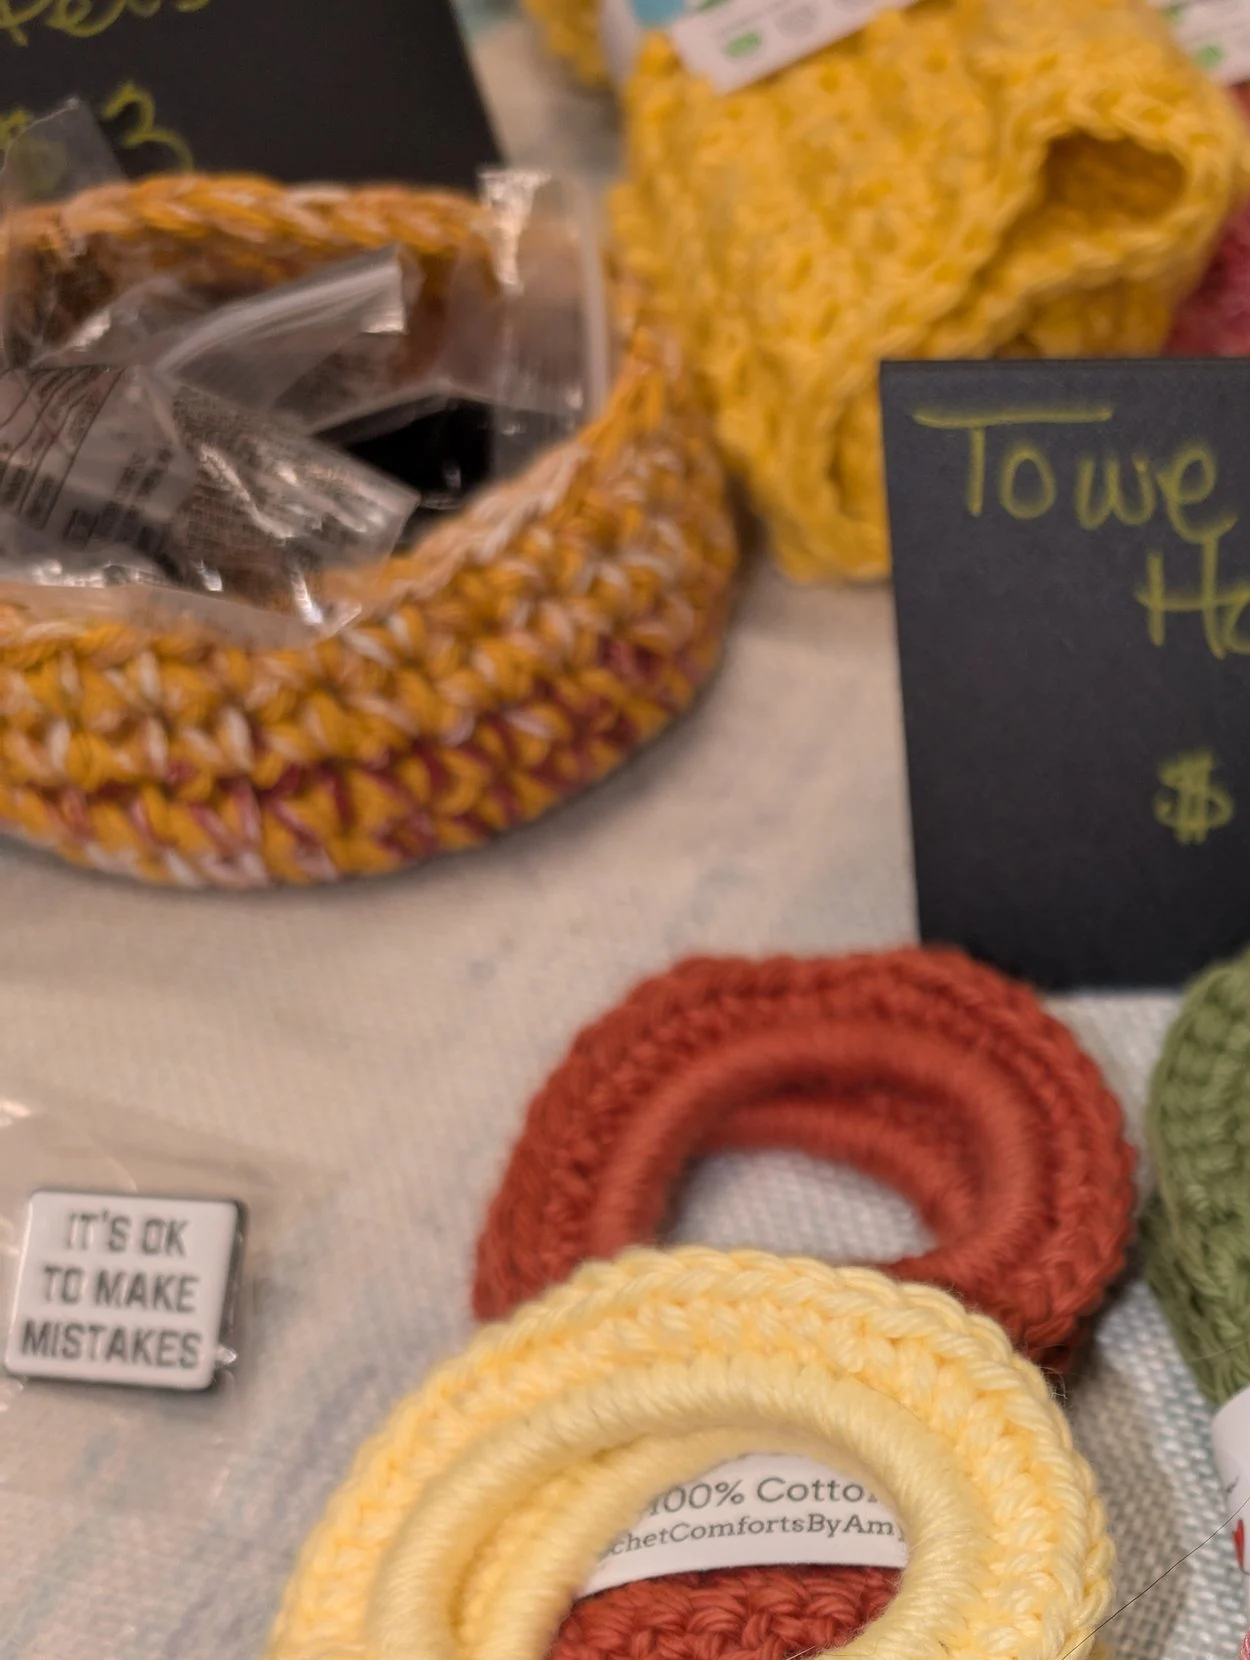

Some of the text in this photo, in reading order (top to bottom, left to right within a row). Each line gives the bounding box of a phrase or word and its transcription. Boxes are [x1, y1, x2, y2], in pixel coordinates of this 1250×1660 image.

[66, 1208, 189, 1257] IT'S OK
[44, 1265, 200, 1314] TO MAKE
[21, 1319, 203, 1369] MISTAKES
